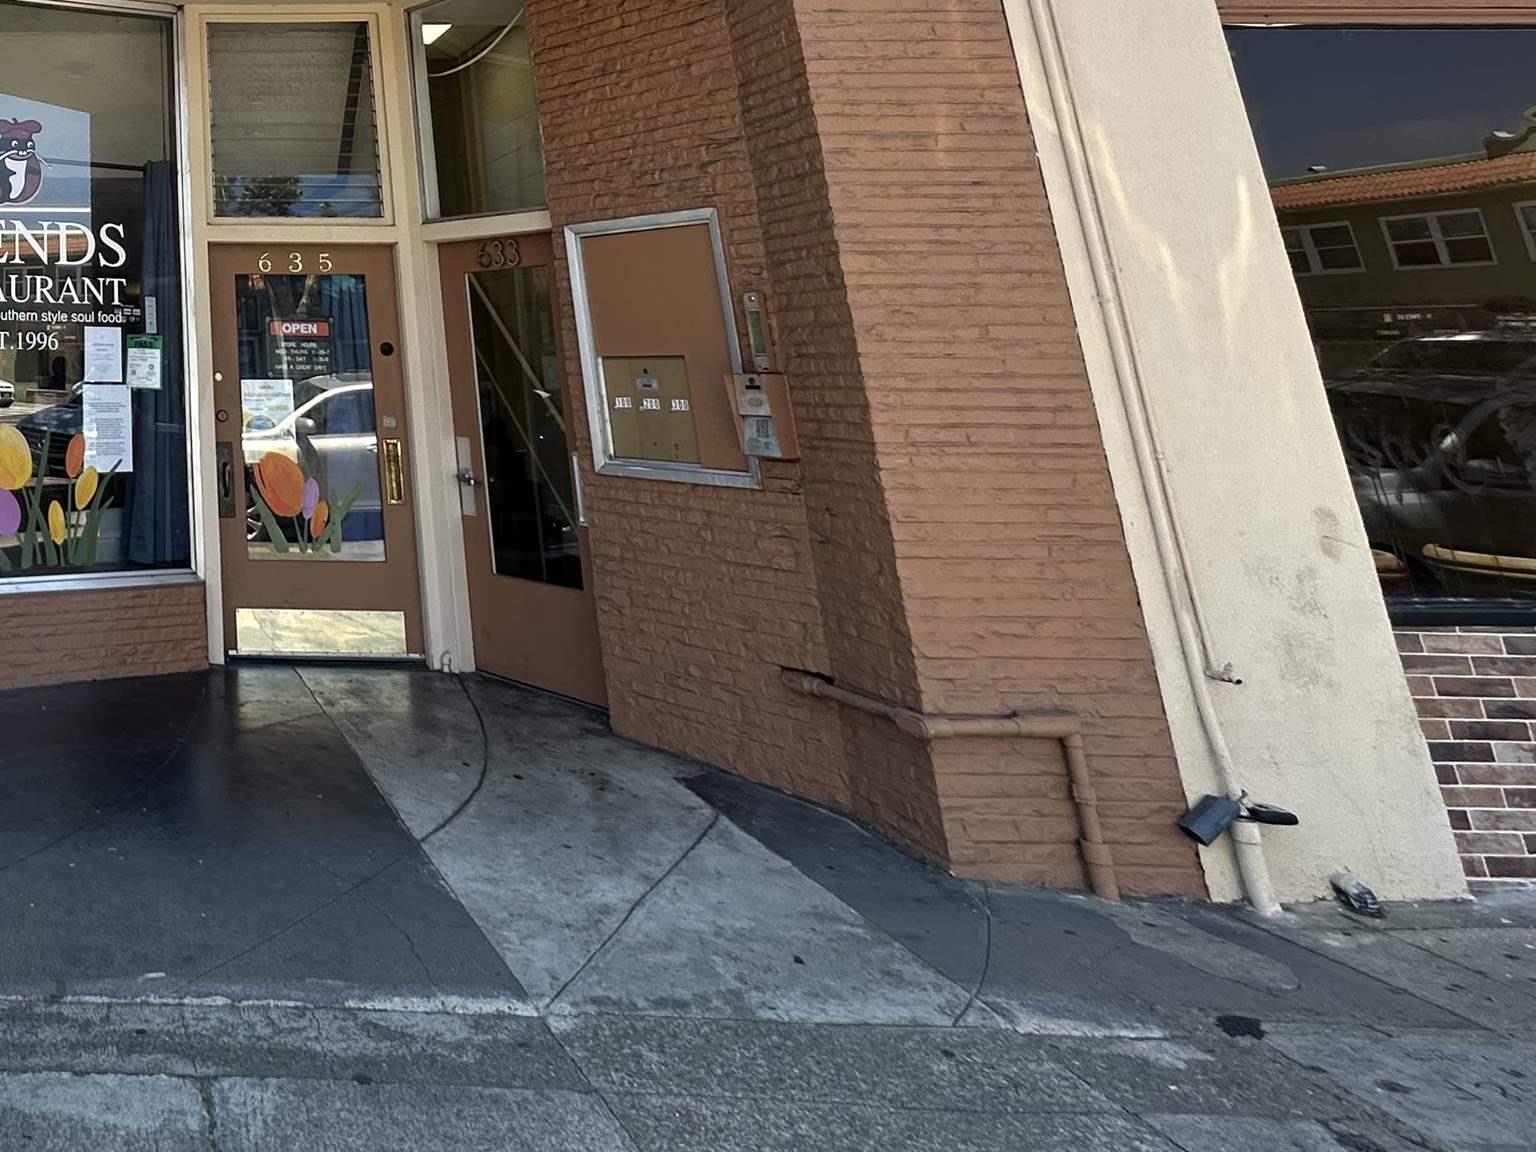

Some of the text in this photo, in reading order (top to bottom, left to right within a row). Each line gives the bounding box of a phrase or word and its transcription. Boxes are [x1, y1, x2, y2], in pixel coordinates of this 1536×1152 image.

[477, 239, 521, 268] 633
[41, 310, 68, 325] style
[71, 310, 95, 323] soul
[282, 323, 317, 334] OPEN
[644, 399, 660, 409] 200
